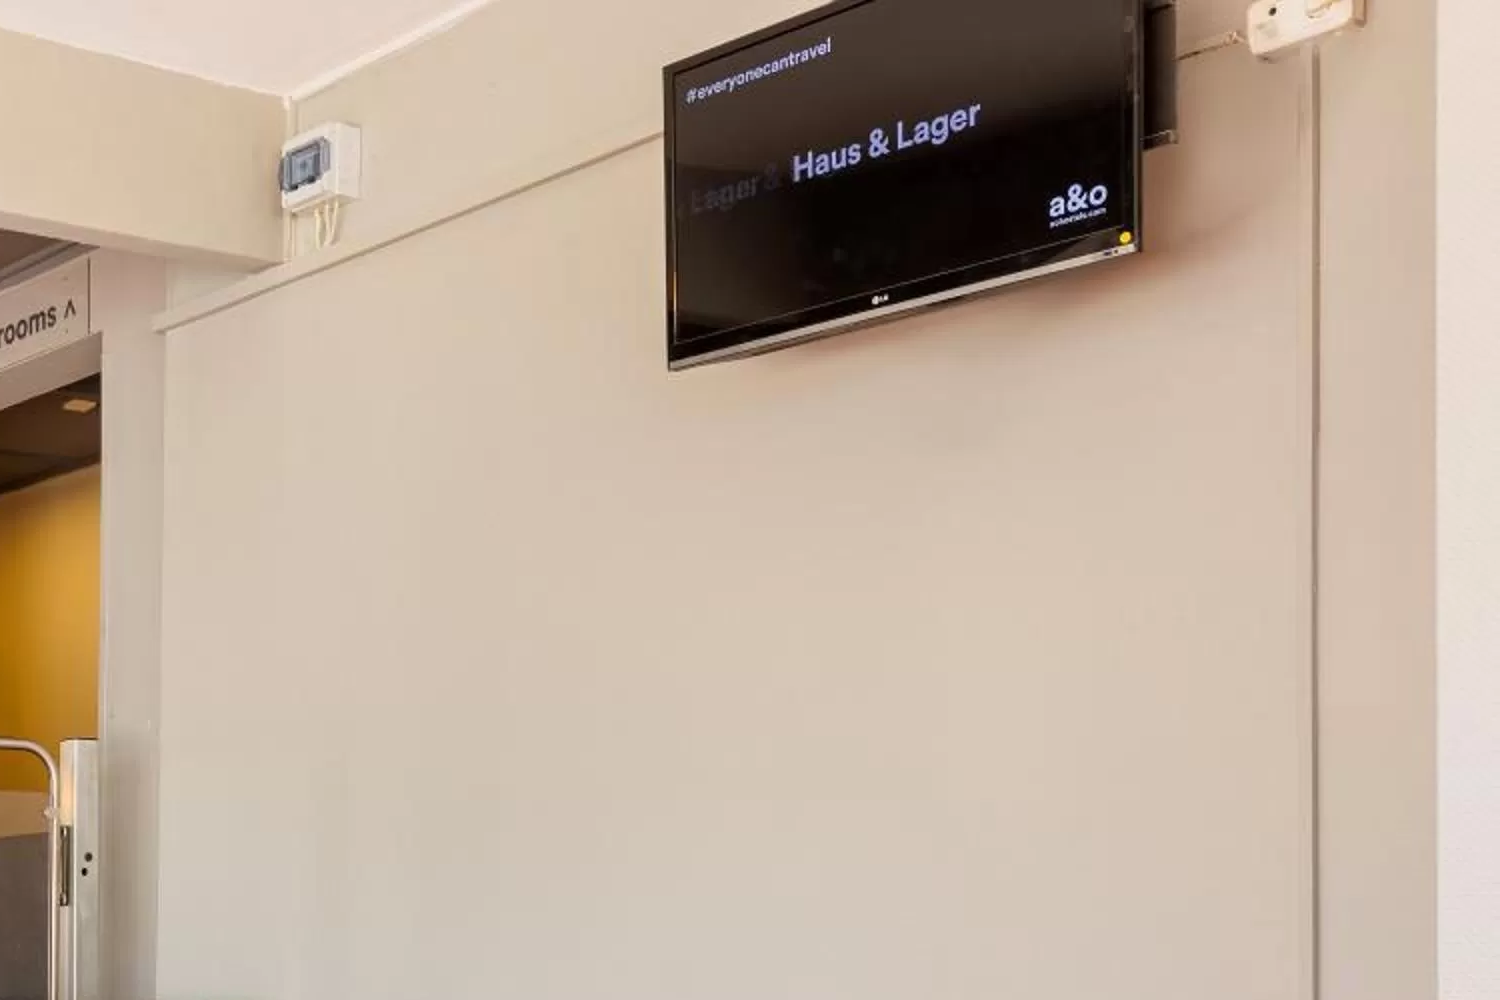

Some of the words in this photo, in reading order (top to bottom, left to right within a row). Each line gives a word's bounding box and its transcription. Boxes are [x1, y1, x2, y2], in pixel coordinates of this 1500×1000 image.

[686, 36, 832, 104] #everyonecantravel
[792, 141, 862, 183] Haus
[868, 127, 891, 158] &
[897, 103, 982, 145] Lager
[1049, 183, 1108, 217] a&o
